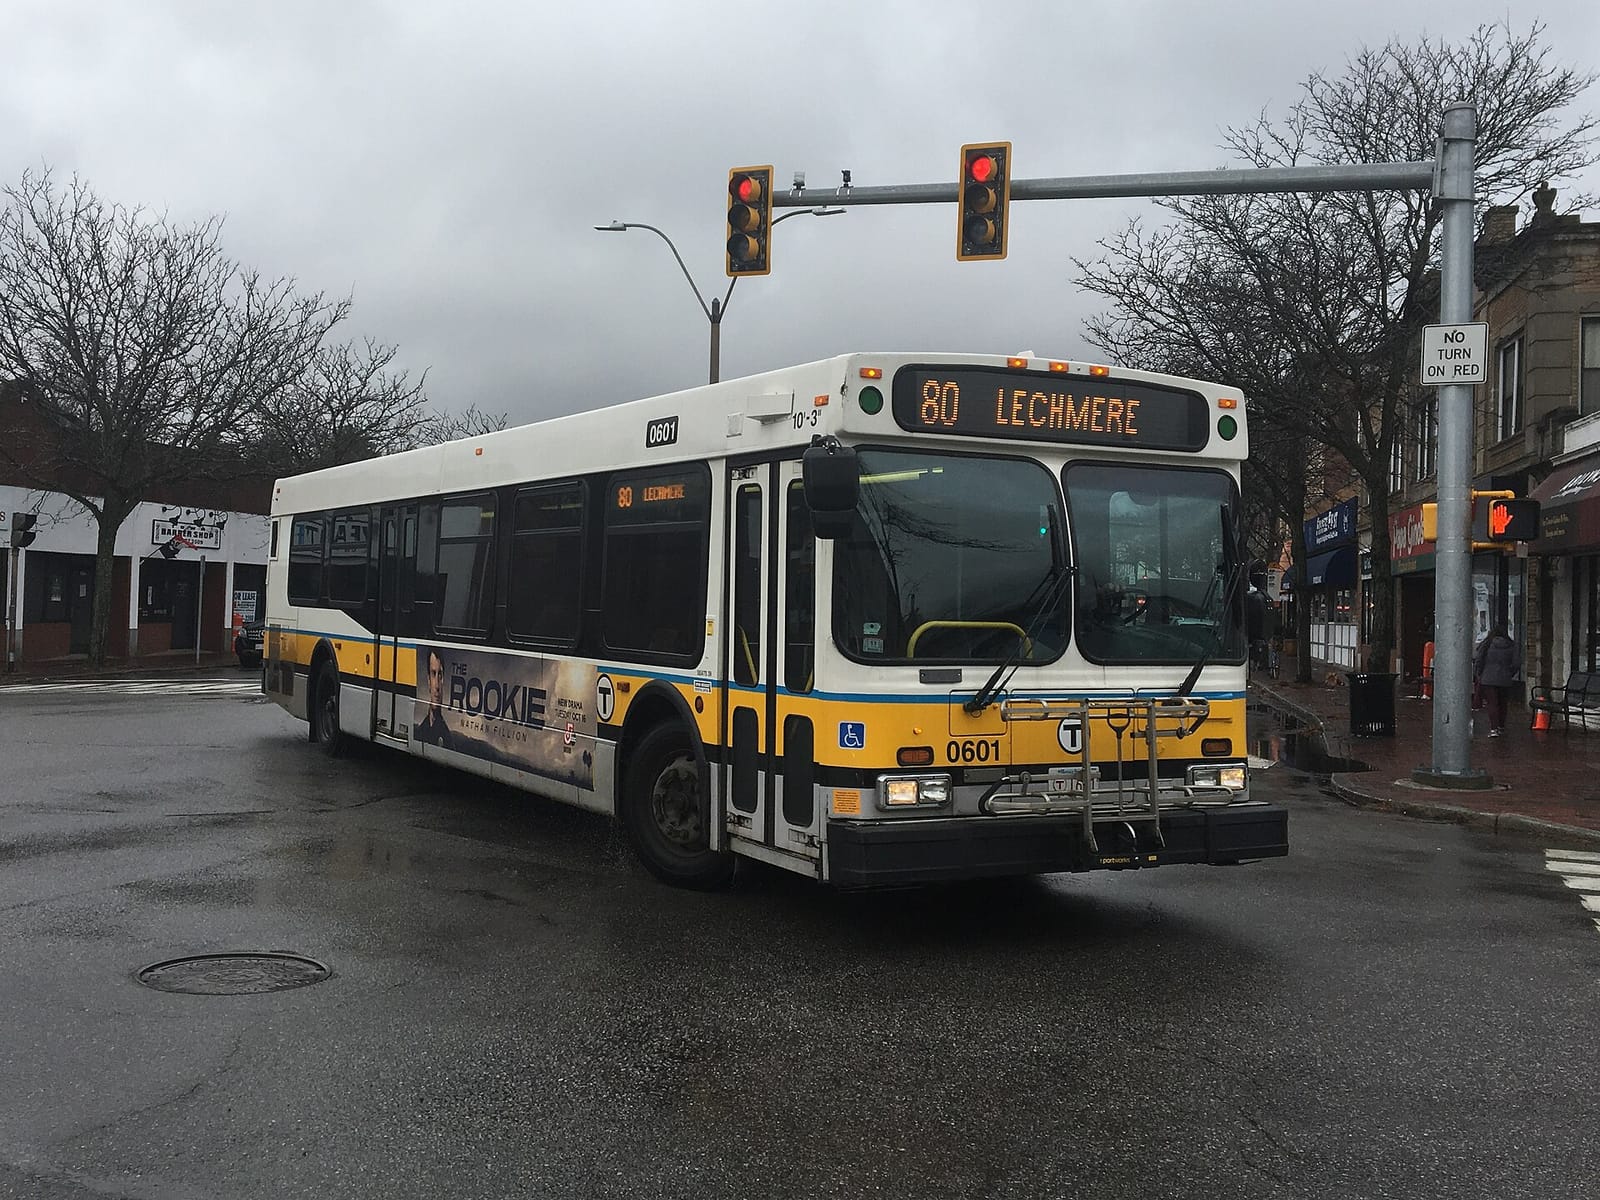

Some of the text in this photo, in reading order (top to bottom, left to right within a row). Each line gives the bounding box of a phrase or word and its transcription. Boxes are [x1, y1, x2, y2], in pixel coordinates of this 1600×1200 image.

[1444, 331, 1465, 343] NO
[1437, 348, 1471, 360] TURN
[1427, 363, 1480, 377] ON RED
[920, 379, 1141, 435] 80 LECHMERE
[649, 421, 677, 444] 0601
[618, 486, 633, 508] 80
[193, 531, 214, 540] SHOP
[451, 662, 468, 676] THE
[450, 675, 547, 731] ROOKIE
[598, 686, 612, 714] T
[459, 718, 528, 743] NATHAN FILLION
[946, 740, 1000, 763] 0601
